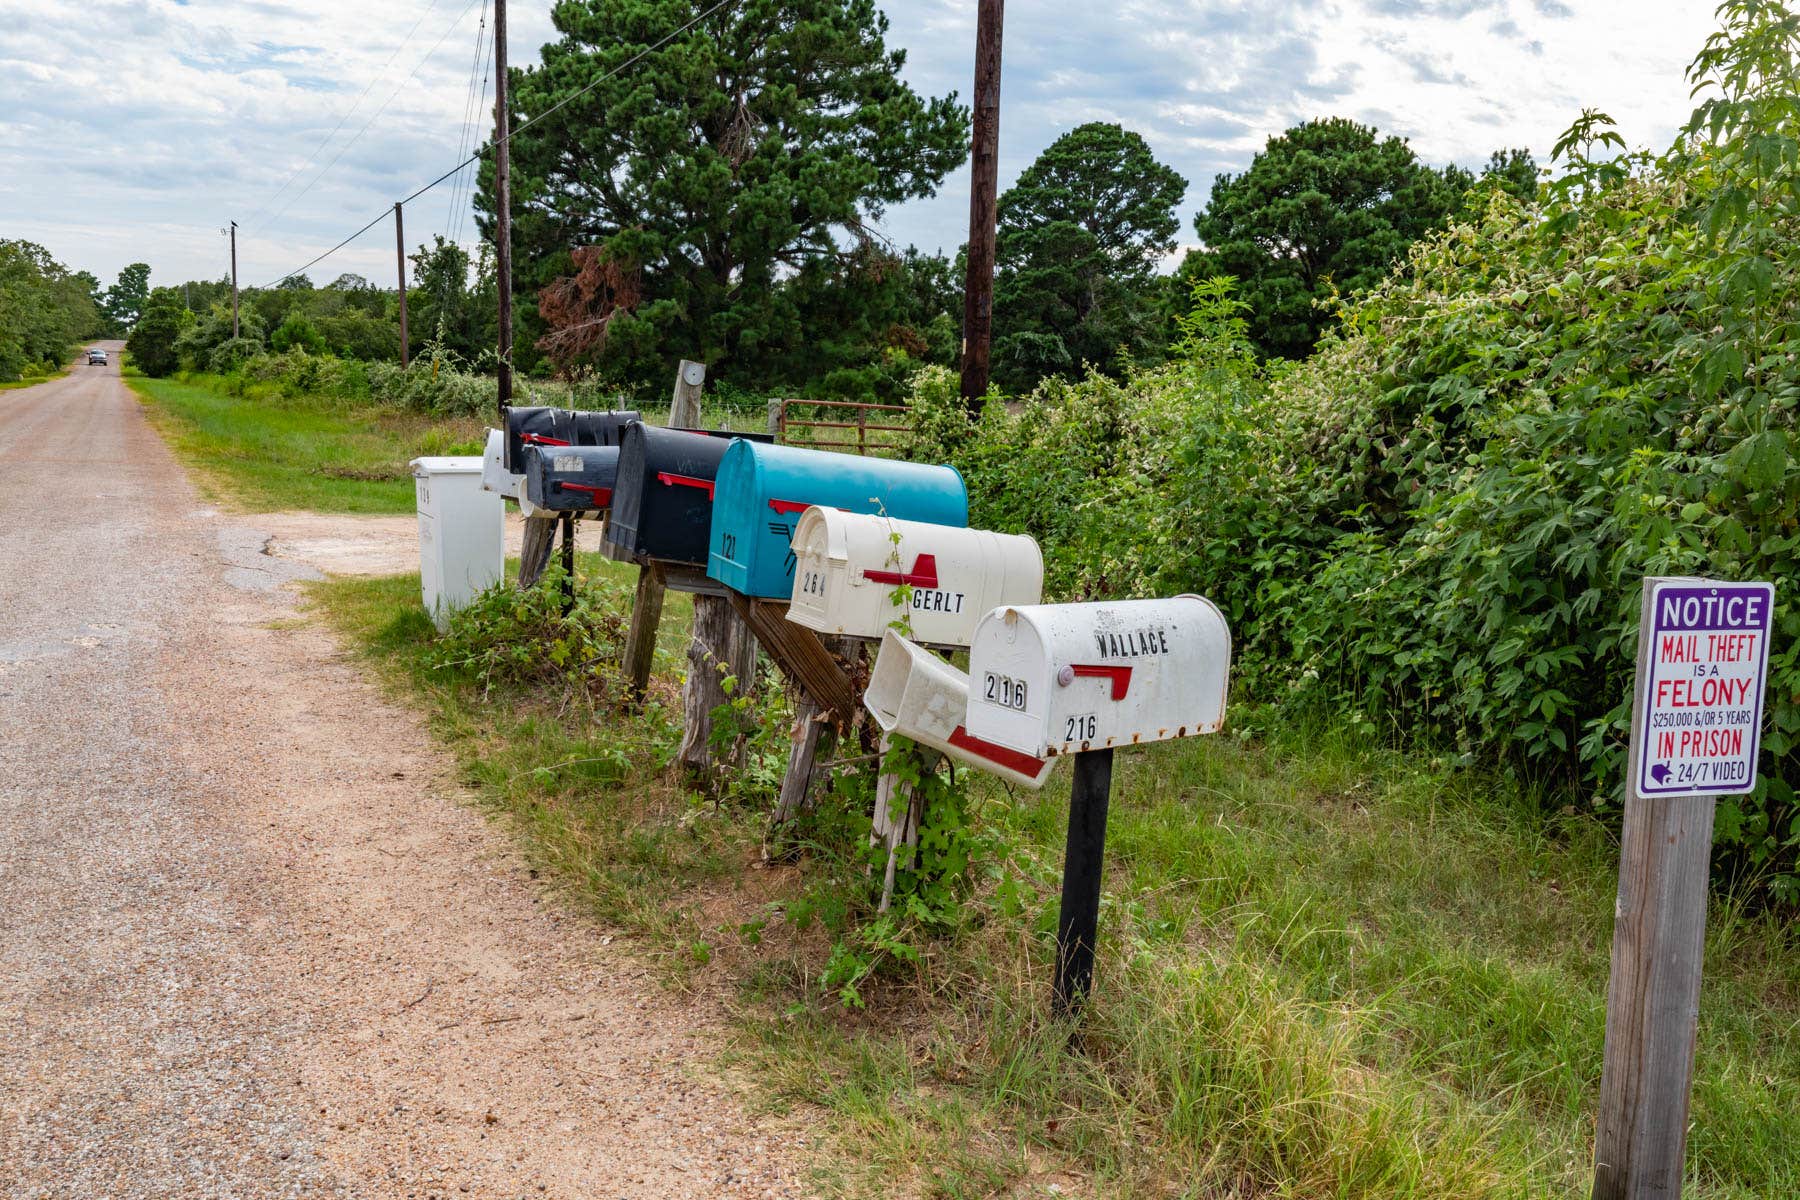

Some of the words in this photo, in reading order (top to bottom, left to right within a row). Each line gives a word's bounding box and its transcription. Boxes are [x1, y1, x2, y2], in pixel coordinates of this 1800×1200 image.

[722, 532, 736, 560] 121
[912, 589, 965, 613] GERLT
[1662, 596, 1762, 627] NOTICE
[1096, 630, 1169, 659] WALLACE
[1661, 635, 1700, 663] MAIL
[1708, 634, 1756, 662] THEFT
[1693, 664, 1706, 677] IS
[1710, 663, 1719, 676] A
[986, 675, 1024, 707] 216
[1656, 678, 1752, 708] FELONY
[1065, 715, 1096, 742] 216
[1694, 710, 1715, 727] &/OR
[1717, 711, 1724, 725] 5
[1726, 710, 1751, 724] YEARS
[1657, 731, 1675, 759] IN
[1680, 729, 1743, 758] PRISON
[1678, 762, 1709, 782] 24/7
[1712, 761, 1745, 781] VIDEO
